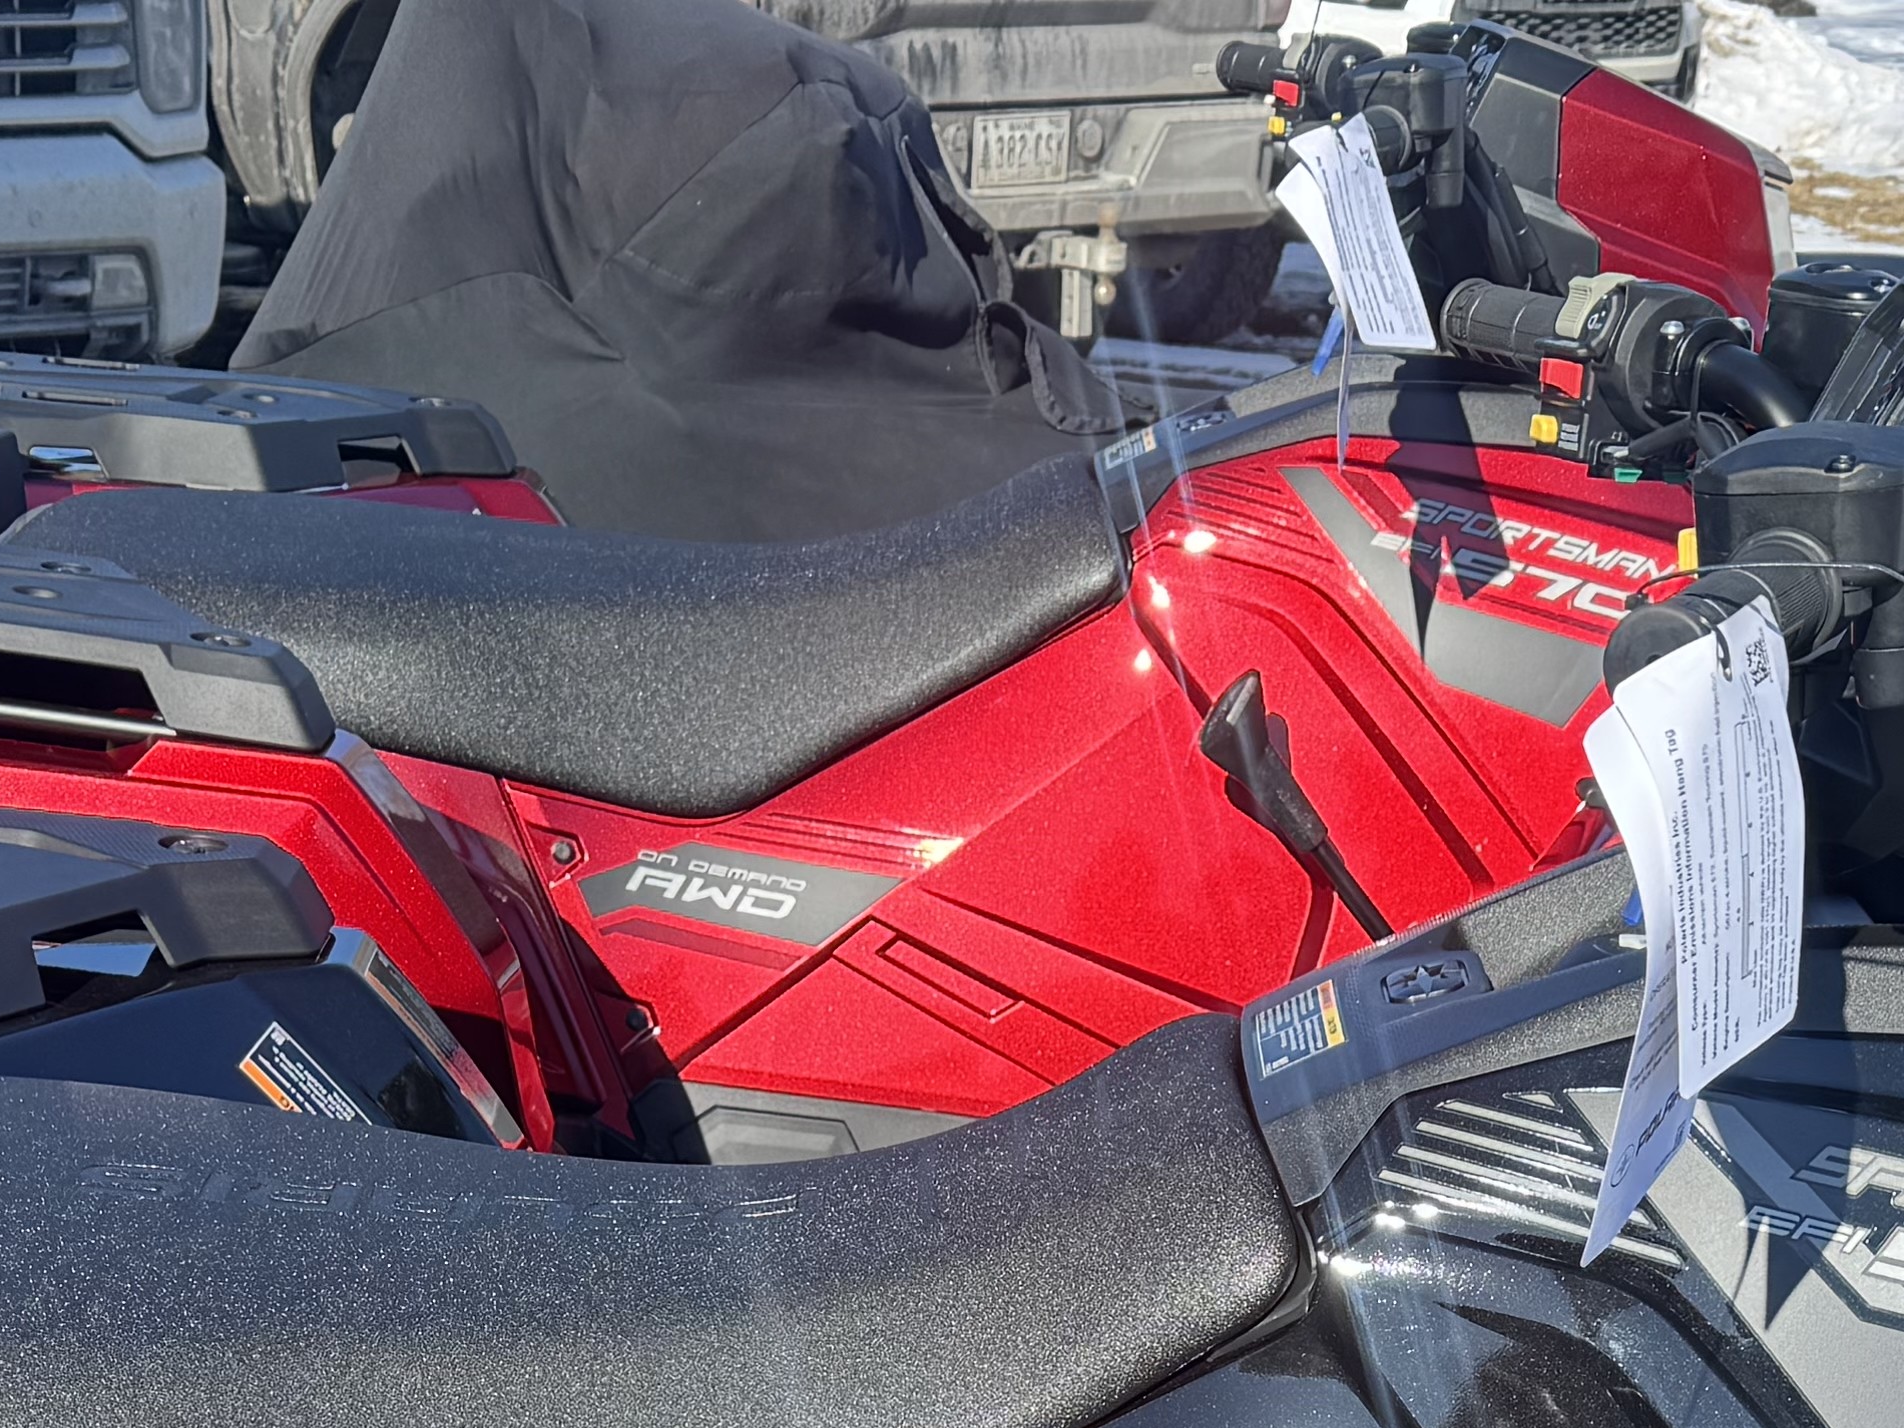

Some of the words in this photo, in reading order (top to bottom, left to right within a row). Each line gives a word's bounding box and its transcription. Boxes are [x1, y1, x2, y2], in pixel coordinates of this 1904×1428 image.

[1399, 497, 1676, 580] SPORTSMAN
[624, 865, 797, 919] AWD
[636, 849, 679, 868] ON
[687, 859, 807, 892] DEMAND
[1737, 1204, 1872, 1255] EFI
